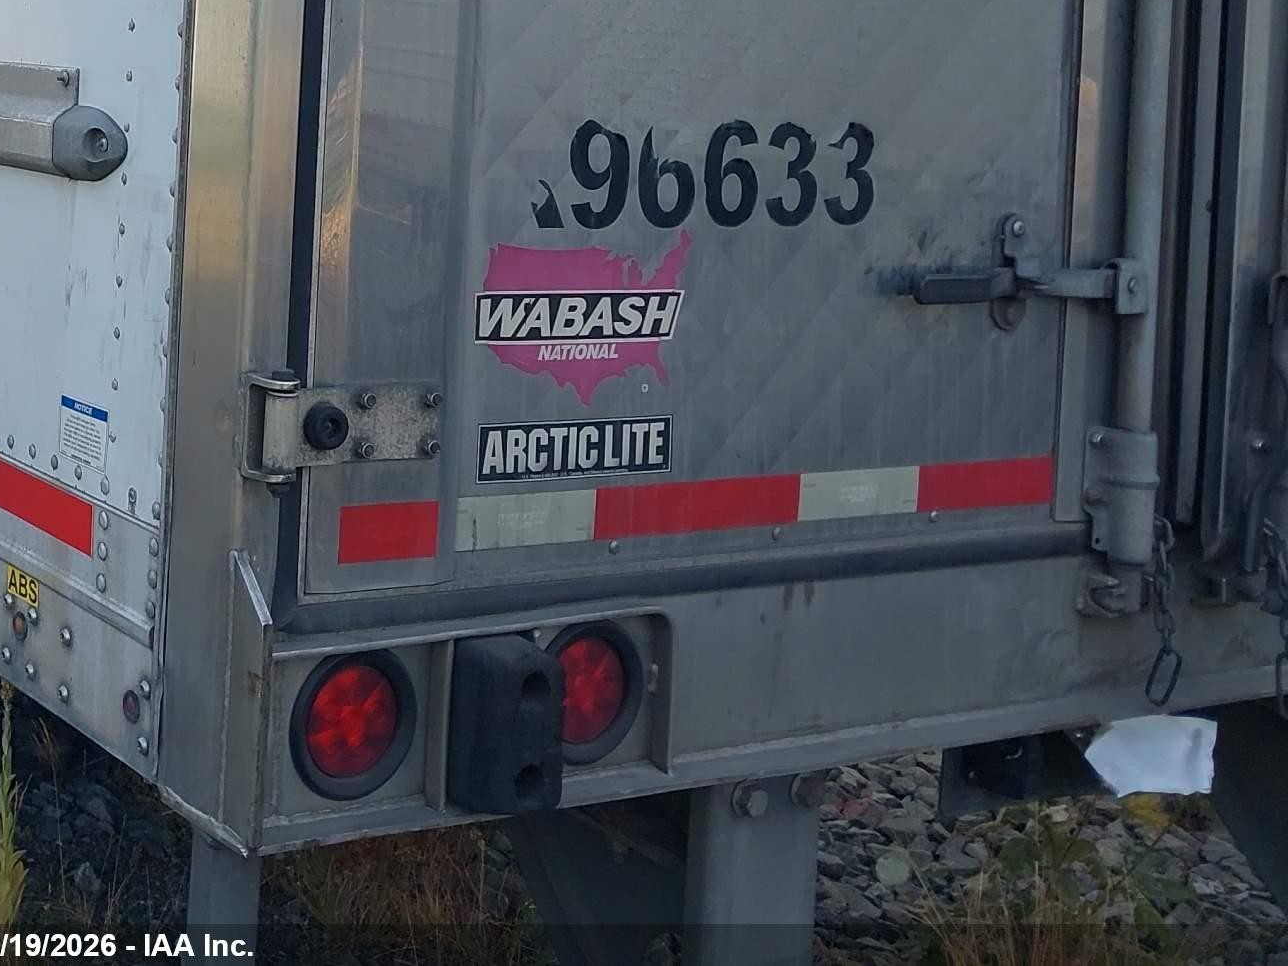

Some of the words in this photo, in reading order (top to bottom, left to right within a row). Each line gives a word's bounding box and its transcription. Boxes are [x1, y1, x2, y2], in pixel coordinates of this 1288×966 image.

[531, 119, 875, 229] 96633
[478, 296, 679, 338] WABASH
[538, 343, 619, 362] NATIONAL
[73, 401, 93, 416] NOTICE
[8, 569, 38, 605] ABS
